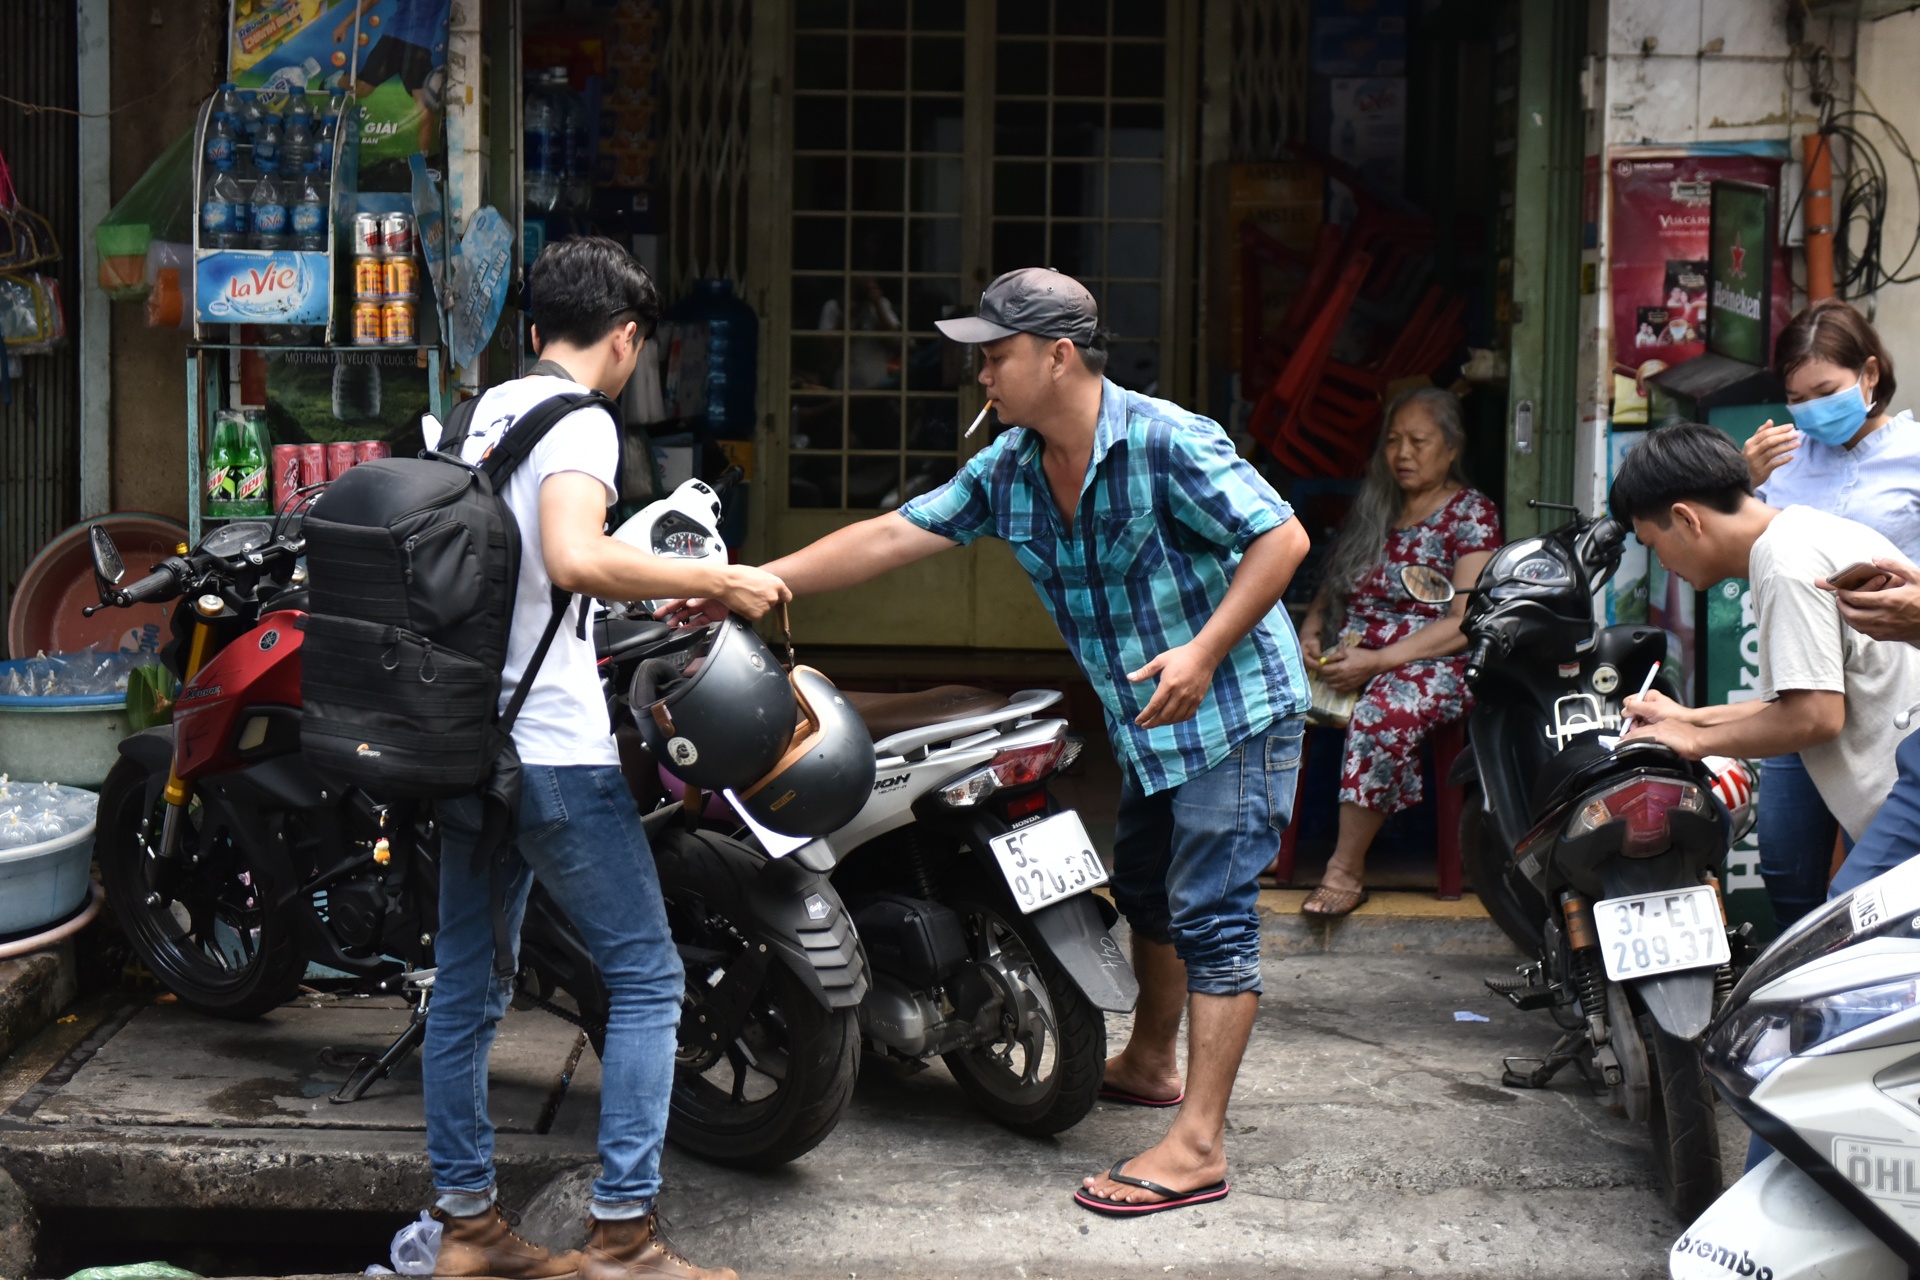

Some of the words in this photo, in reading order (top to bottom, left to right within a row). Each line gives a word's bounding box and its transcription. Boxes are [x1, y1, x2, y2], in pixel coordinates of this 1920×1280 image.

[1713, 279, 1762, 320] Heineken
[1012, 814, 1041, 829] HONDA
[1613, 894, 1700, 936] 37-E1
[1612, 926, 1715, 974] 289.37
[1674, 1232, 1774, 1280] brembo
